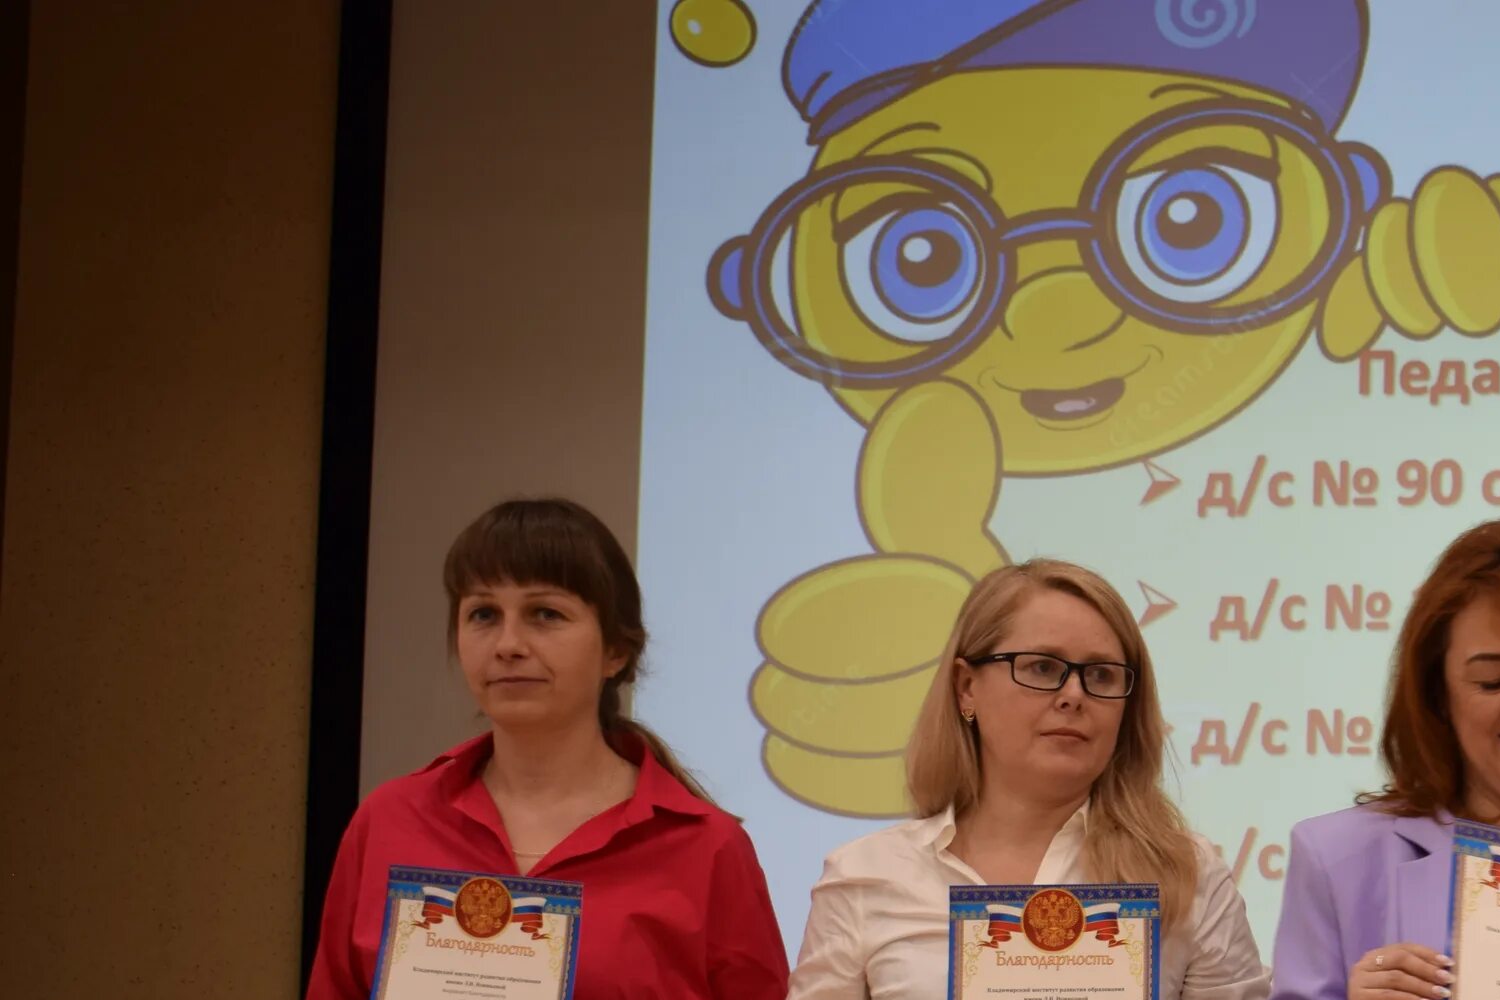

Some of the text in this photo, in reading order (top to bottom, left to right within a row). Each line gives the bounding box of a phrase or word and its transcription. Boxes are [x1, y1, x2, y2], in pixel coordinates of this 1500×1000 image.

[1197, 454, 1295, 518] д/с
[1313, 458, 1380, 507] №
[1396, 458, 1464, 507] 90
[1209, 577, 1307, 642] д/с
[1324, 583, 1392, 632] №
[1191, 701, 1289, 767] д/с
[1305, 708, 1374, 757] №
[995, 951, 1114, 971] Благодарность
